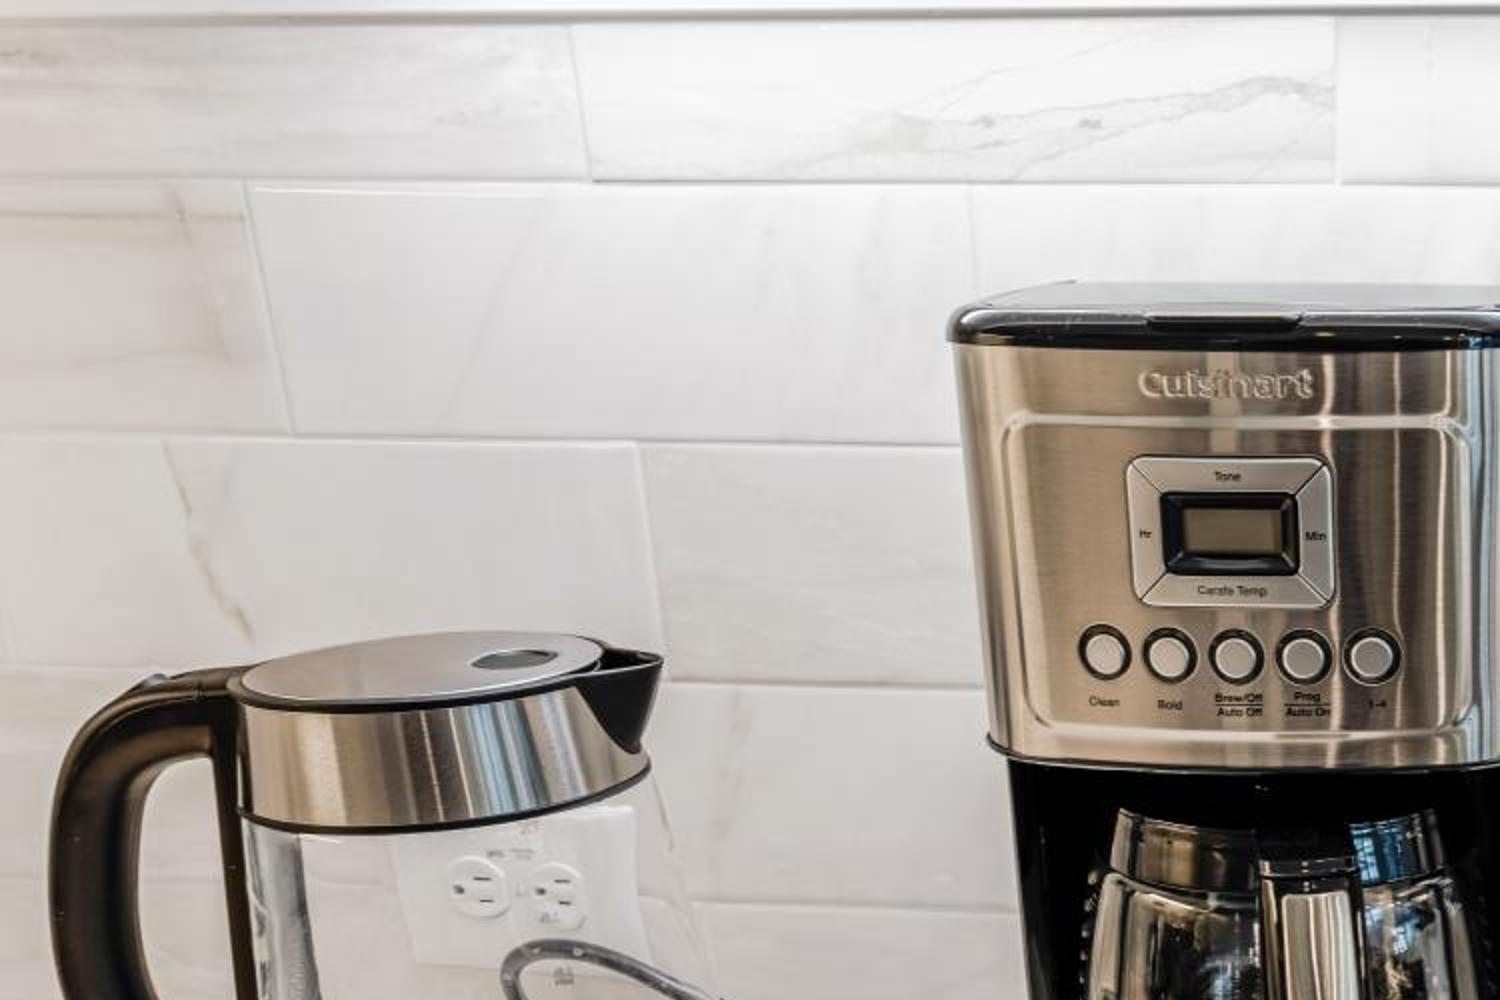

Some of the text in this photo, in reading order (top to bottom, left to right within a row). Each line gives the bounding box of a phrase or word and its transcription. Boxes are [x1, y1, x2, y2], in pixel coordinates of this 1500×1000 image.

[1138, 369, 1313, 399] Cuisinart
[1214, 471, 1241, 482] Tone
[1139, 530, 1153, 539] Hr
[1305, 531, 1327, 541] Min
[1197, 585, 1268, 598] Carafe Temp
[1088, 696, 1121, 706] Clean
[1215, 693, 1264, 703] Brew/Off
[1294, 691, 1321, 703] Prog
[1157, 699, 1184, 710] Bold
[1216, 706, 1263, 717] Auto Off
[1285, 706, 1331, 717] Auto On
